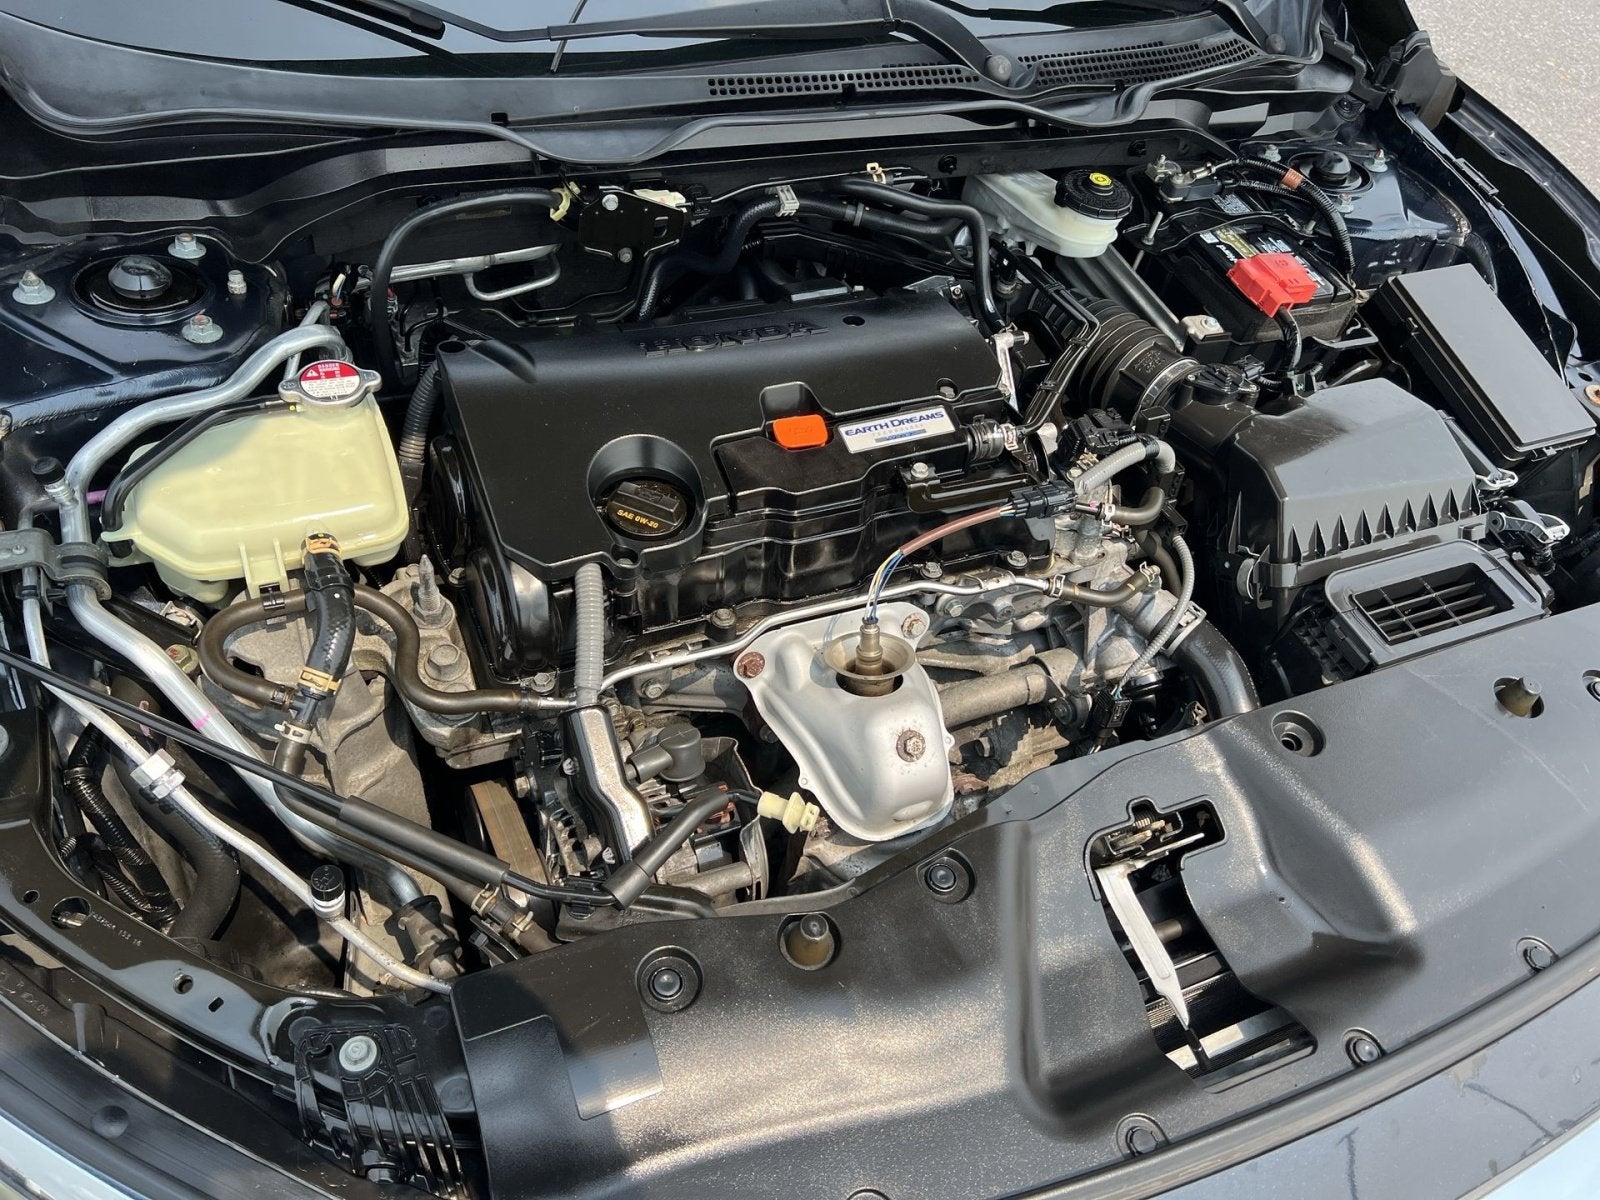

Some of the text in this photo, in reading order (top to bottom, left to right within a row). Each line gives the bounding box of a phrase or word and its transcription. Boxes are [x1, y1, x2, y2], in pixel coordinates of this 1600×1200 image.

[640, 323, 829, 357] HONDA
[845, 423, 889, 437] EARTH
[890, 411, 944, 427] DREAMS
[616, 509, 659, 529] SAE 0W-20
